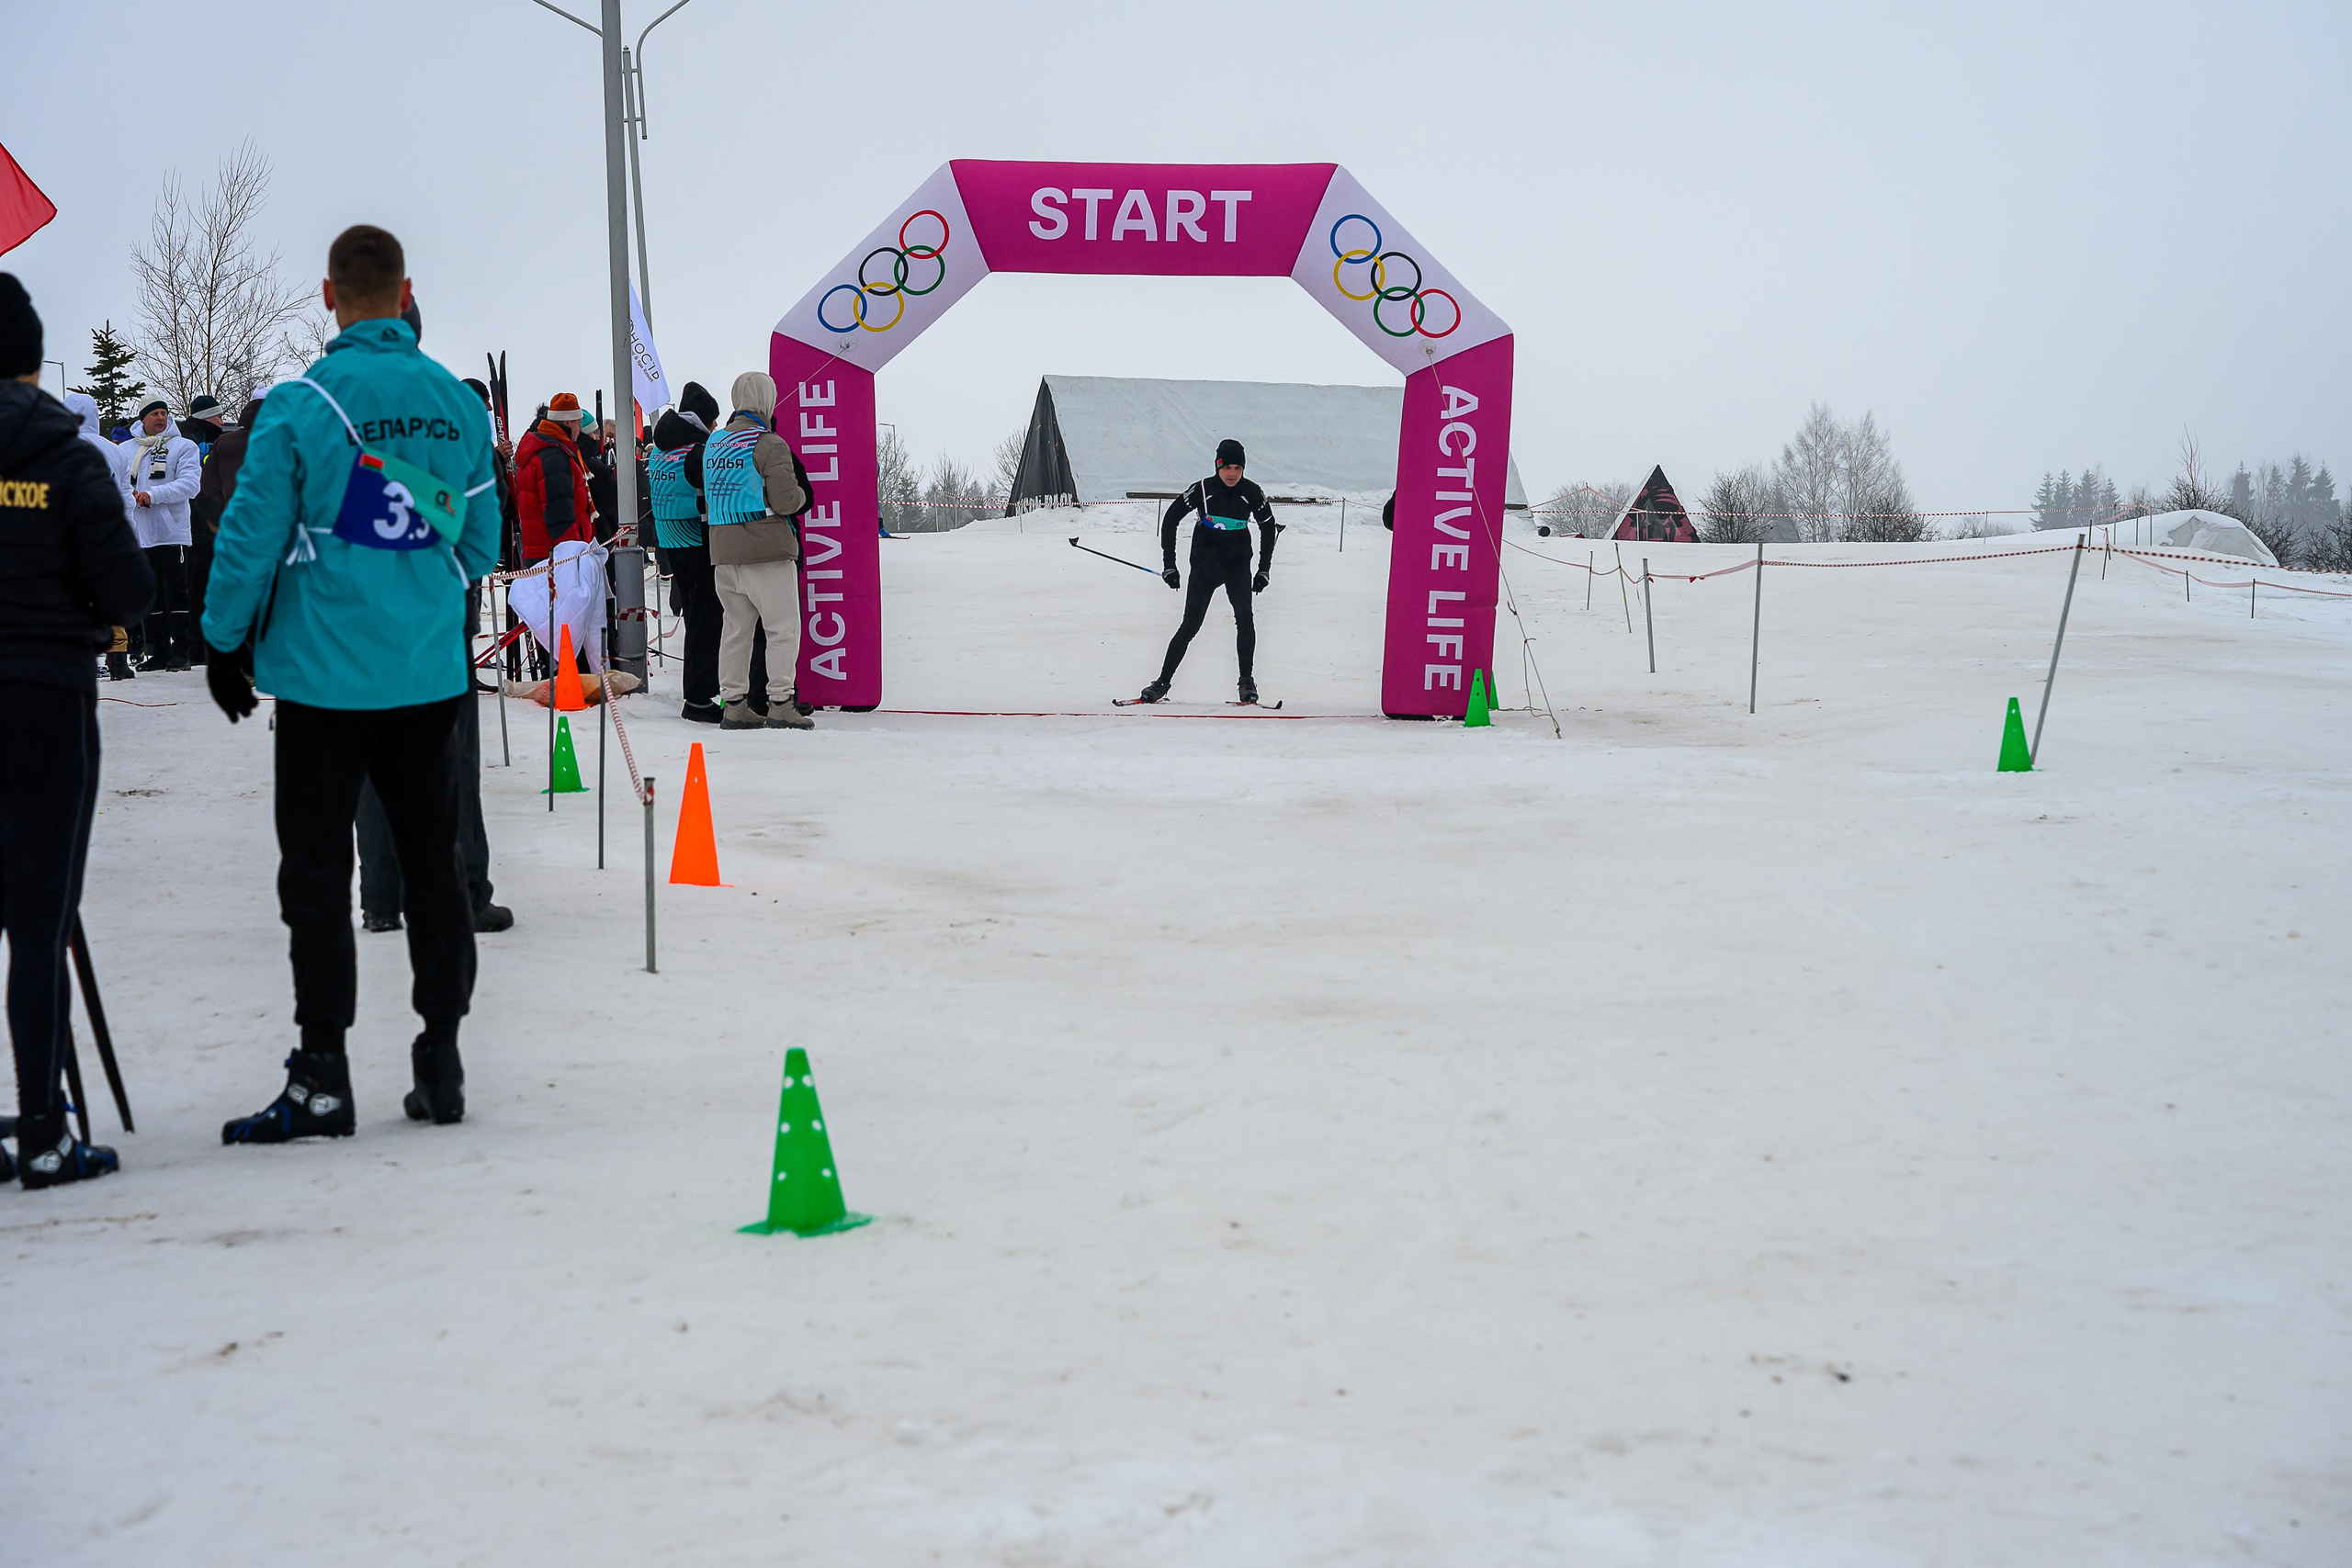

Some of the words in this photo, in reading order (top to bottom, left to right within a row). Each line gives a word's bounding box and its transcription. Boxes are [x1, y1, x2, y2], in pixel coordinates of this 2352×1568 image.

[1028, 186, 1252, 243] START
[345, 416, 460, 446] БЕЛАРУСЬ
[706, 457, 744, 470] СУДЬЯ
[798, 379, 839, 481] LIFE
[0, 479, 50, 509] СКОЕ
[1430, 385, 1479, 571] ACTIVE
[804, 501, 847, 681] ACTIVE
[1424, 590, 1466, 691] LIFE
